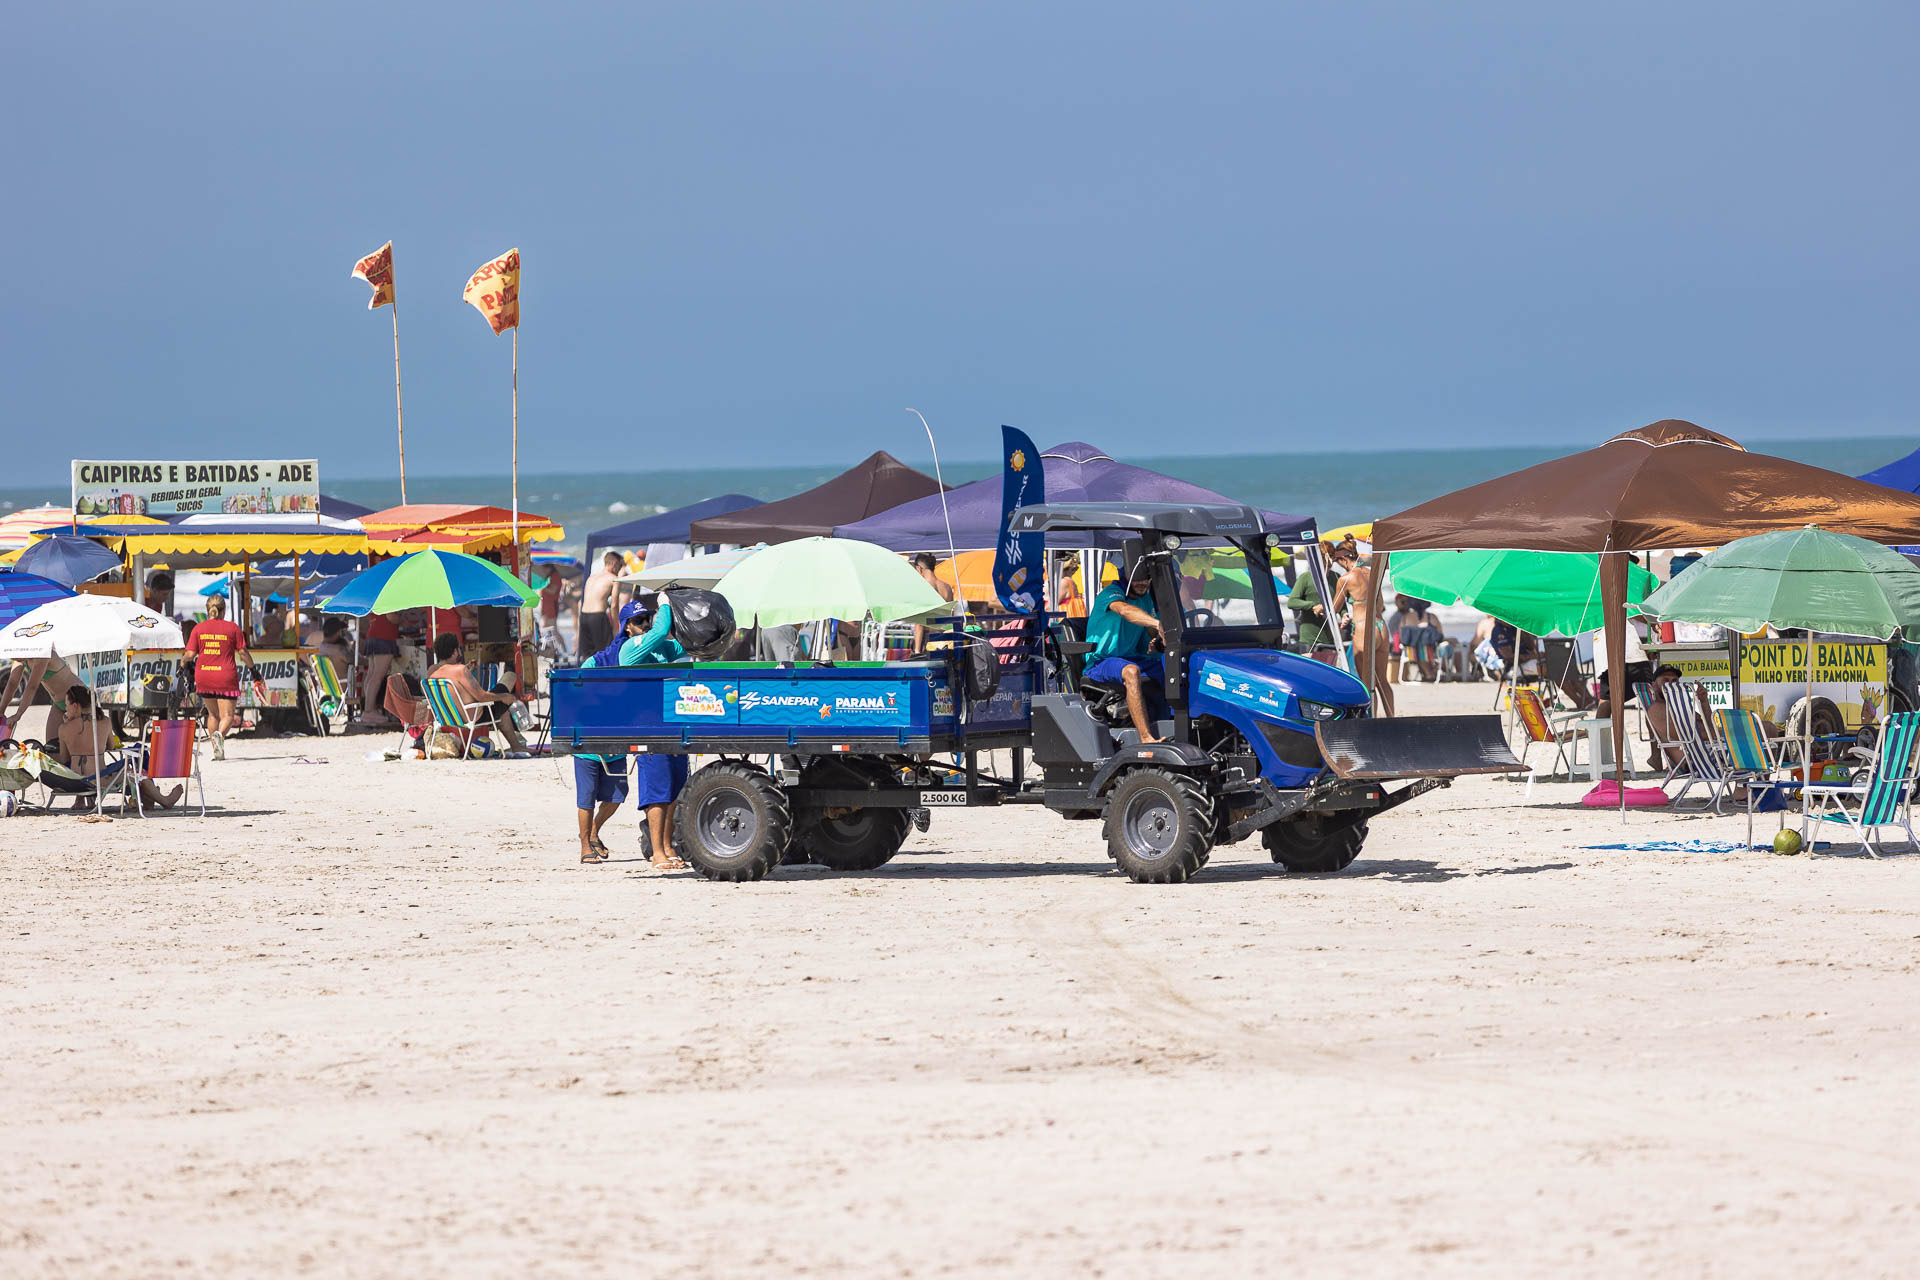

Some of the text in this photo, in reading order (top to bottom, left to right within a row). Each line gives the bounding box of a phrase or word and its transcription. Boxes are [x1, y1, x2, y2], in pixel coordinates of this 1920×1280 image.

[80, 465, 162, 483] CAIPIRAS
[169, 465, 178, 483] E
[186, 464, 259, 483] BATIDAS
[278, 464, 312, 482] ADE
[151, 486, 222, 503] BEBIDAS EM GERAL
[176, 500, 203, 512] SUCOS
[101, 650, 122, 665] VERDE
[1739, 644, 1876, 668] POINT DA BAIANA
[1687, 662, 1698, 672] DA
[1700, 662, 1729, 672] BAIANA
[96, 667, 126, 688] BEBIDAS
[1755, 670, 1783, 683] MILHO
[1816, 670, 1821, 682] E
[1823, 670, 1869, 683] PAMONHA
[1702, 681, 1731, 692] ERDE
[760, 696, 819, 707] SANEPAR
[835, 695, 885, 708] PARANÁ
[989, 692, 1013, 702] NEPAR
[922, 793, 966, 803] 2.500 KG
